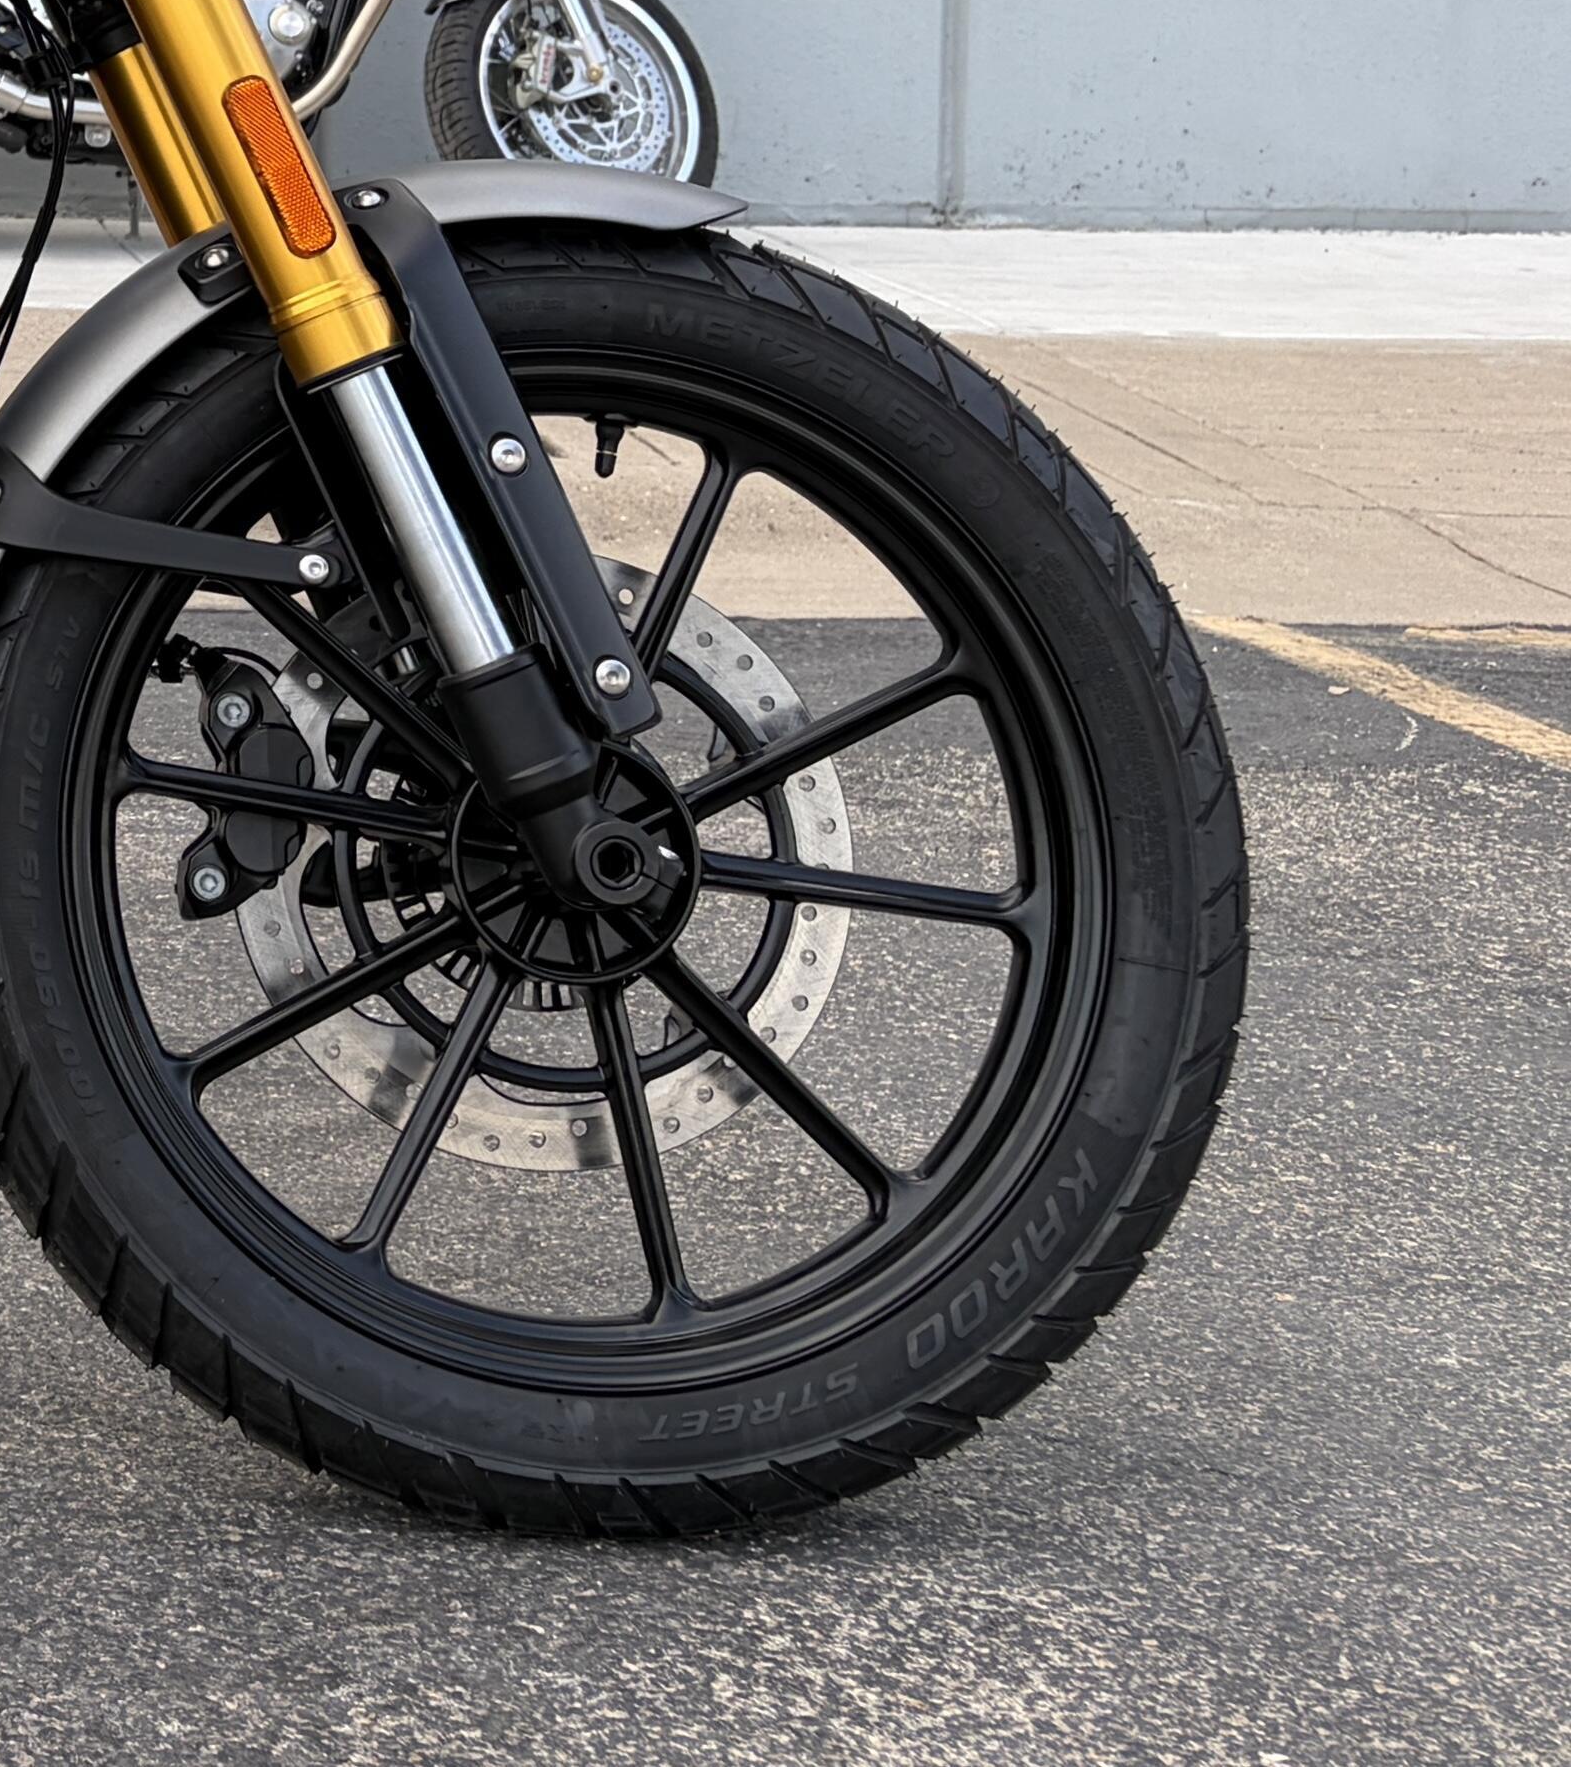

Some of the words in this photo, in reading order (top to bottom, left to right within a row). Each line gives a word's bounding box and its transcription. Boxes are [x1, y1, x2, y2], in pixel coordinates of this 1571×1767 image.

[646, 301, 956, 466] METZELER
[905, 1147, 1100, 1370] KAROO
[637, 1361, 858, 1443] STREET
